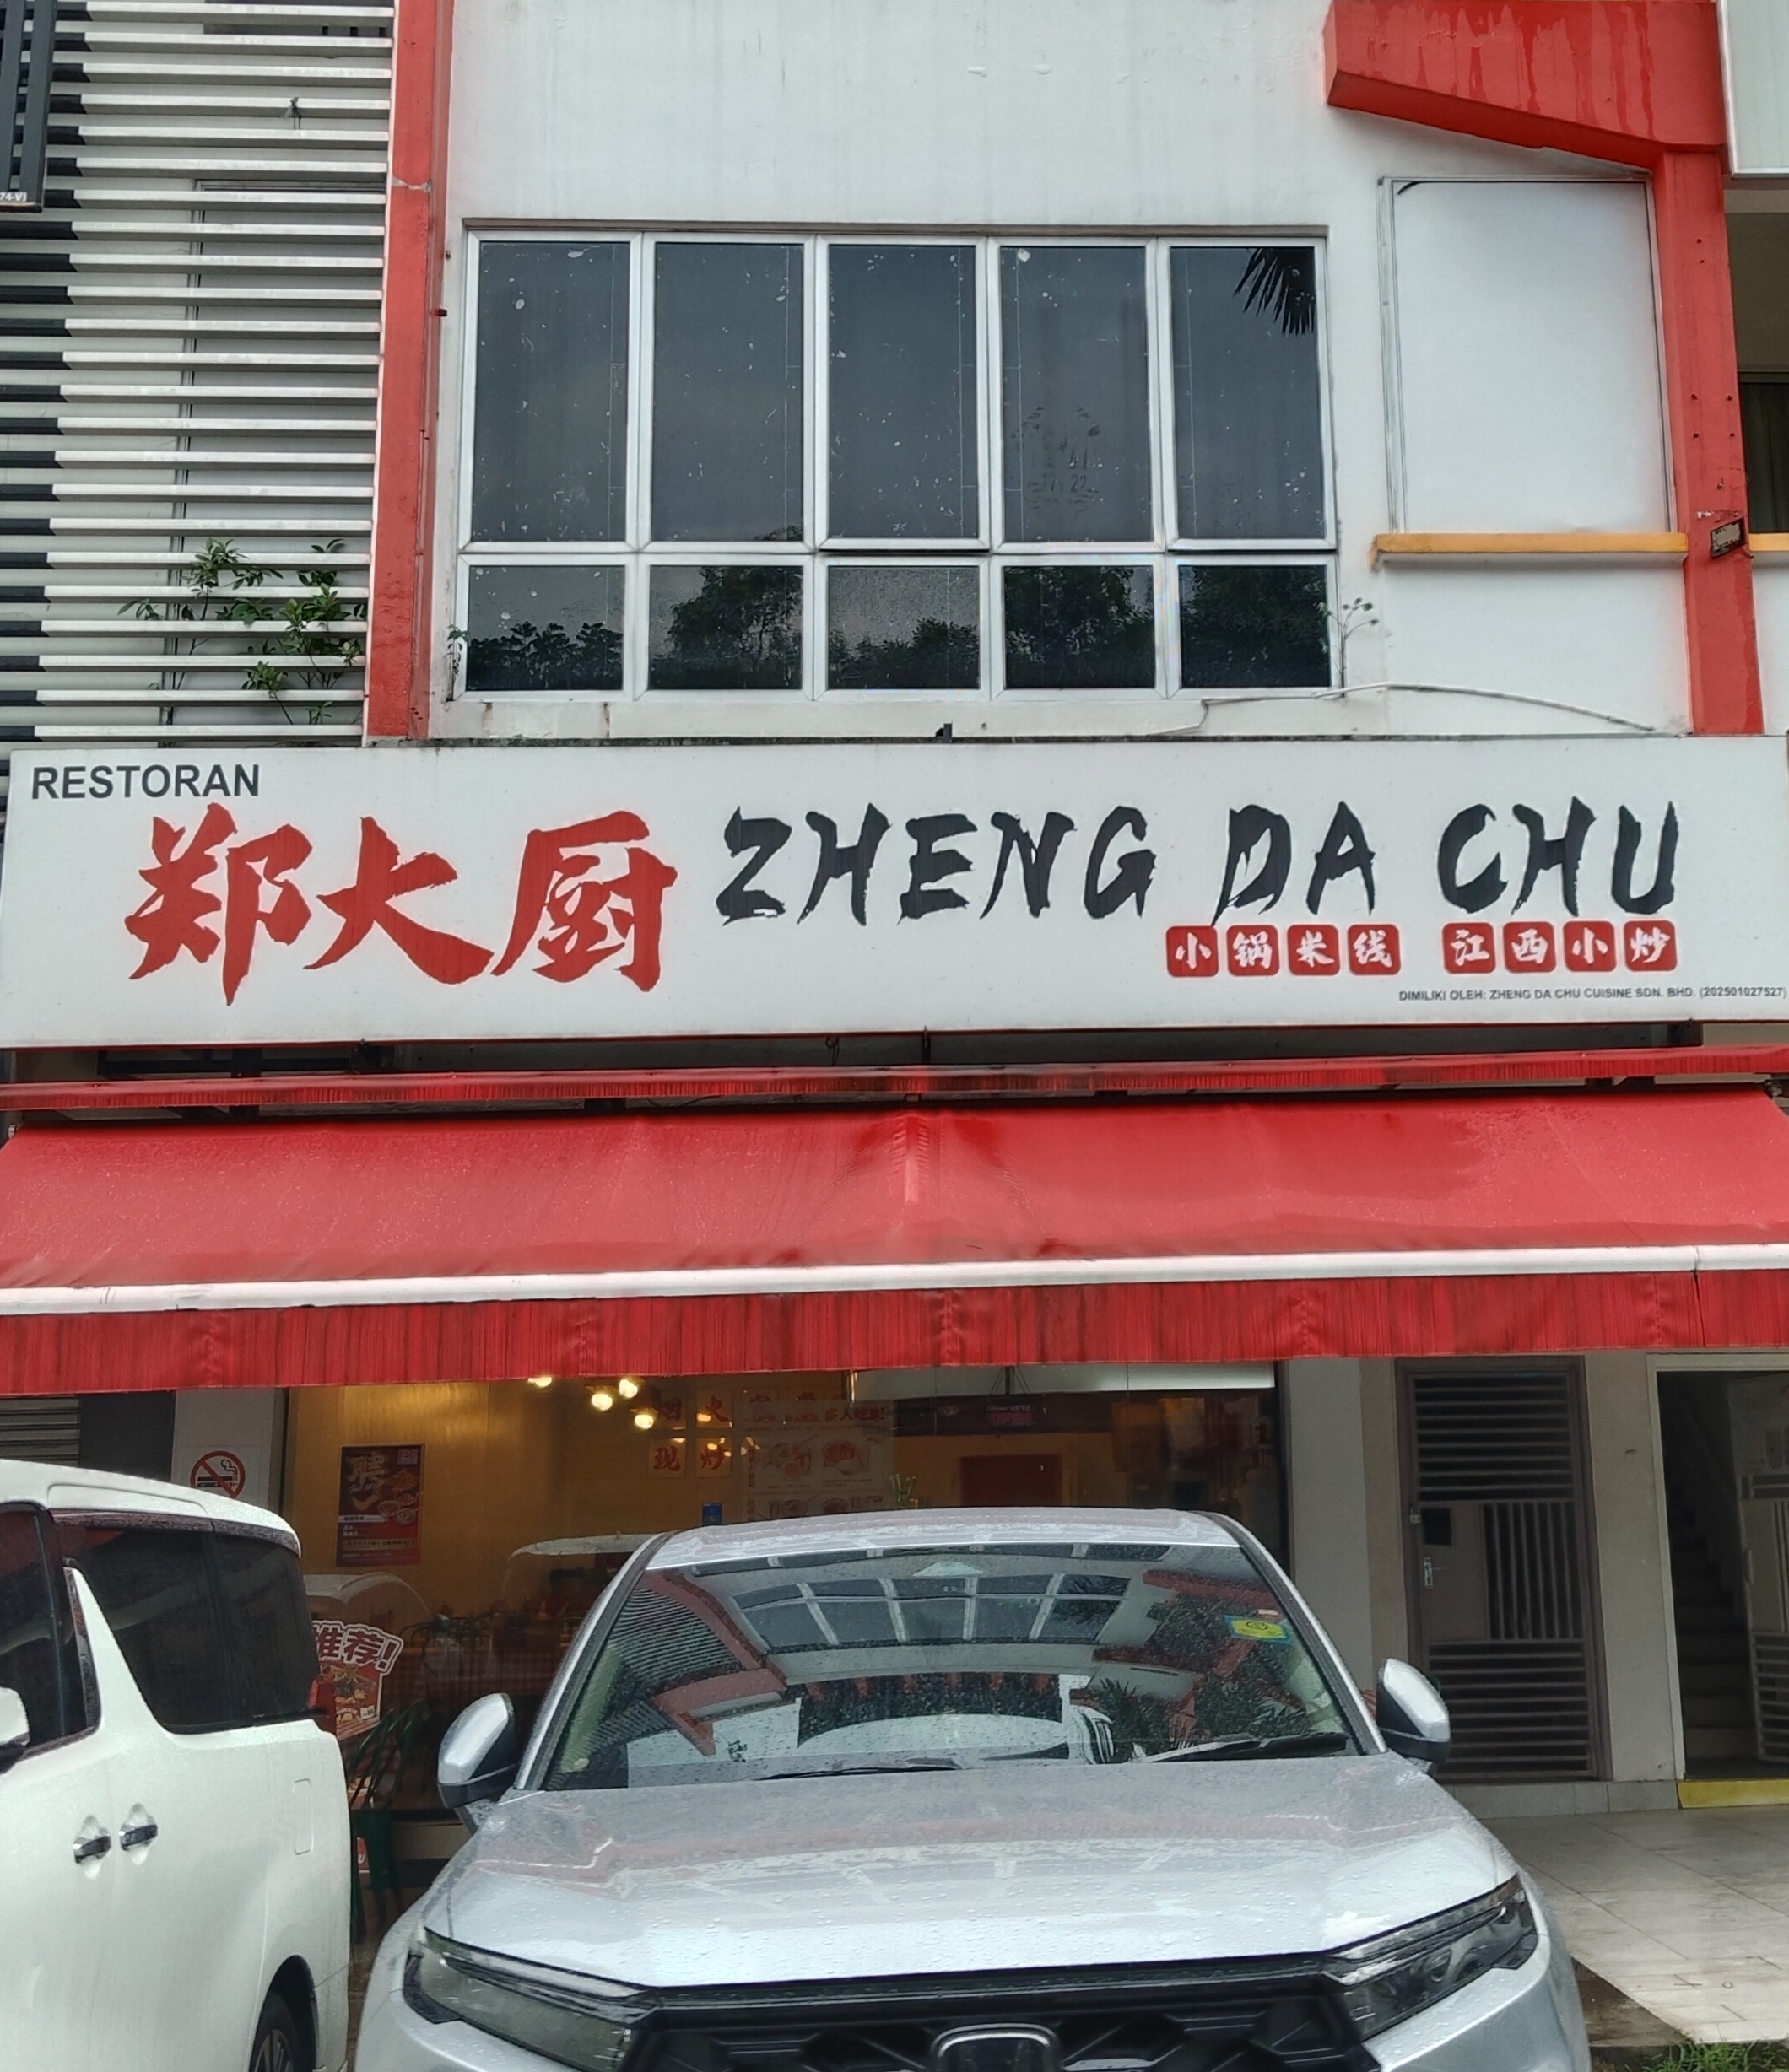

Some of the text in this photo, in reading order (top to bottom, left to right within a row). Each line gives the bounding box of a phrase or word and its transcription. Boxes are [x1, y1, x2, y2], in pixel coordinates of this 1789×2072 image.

[32, 764, 259, 800] RESTORAN
[716, 796, 1679, 928] ZHENG DA CHU
[125, 803, 678, 1005] 郑大厨
[1176, 925, 1672, 969] 小锅米线 江西小炒
[1399, 986, 1787, 1001] DIMILIKI OLEH: ZHENG DA CHU CUISINE SDN. BHD. (202501027527)
